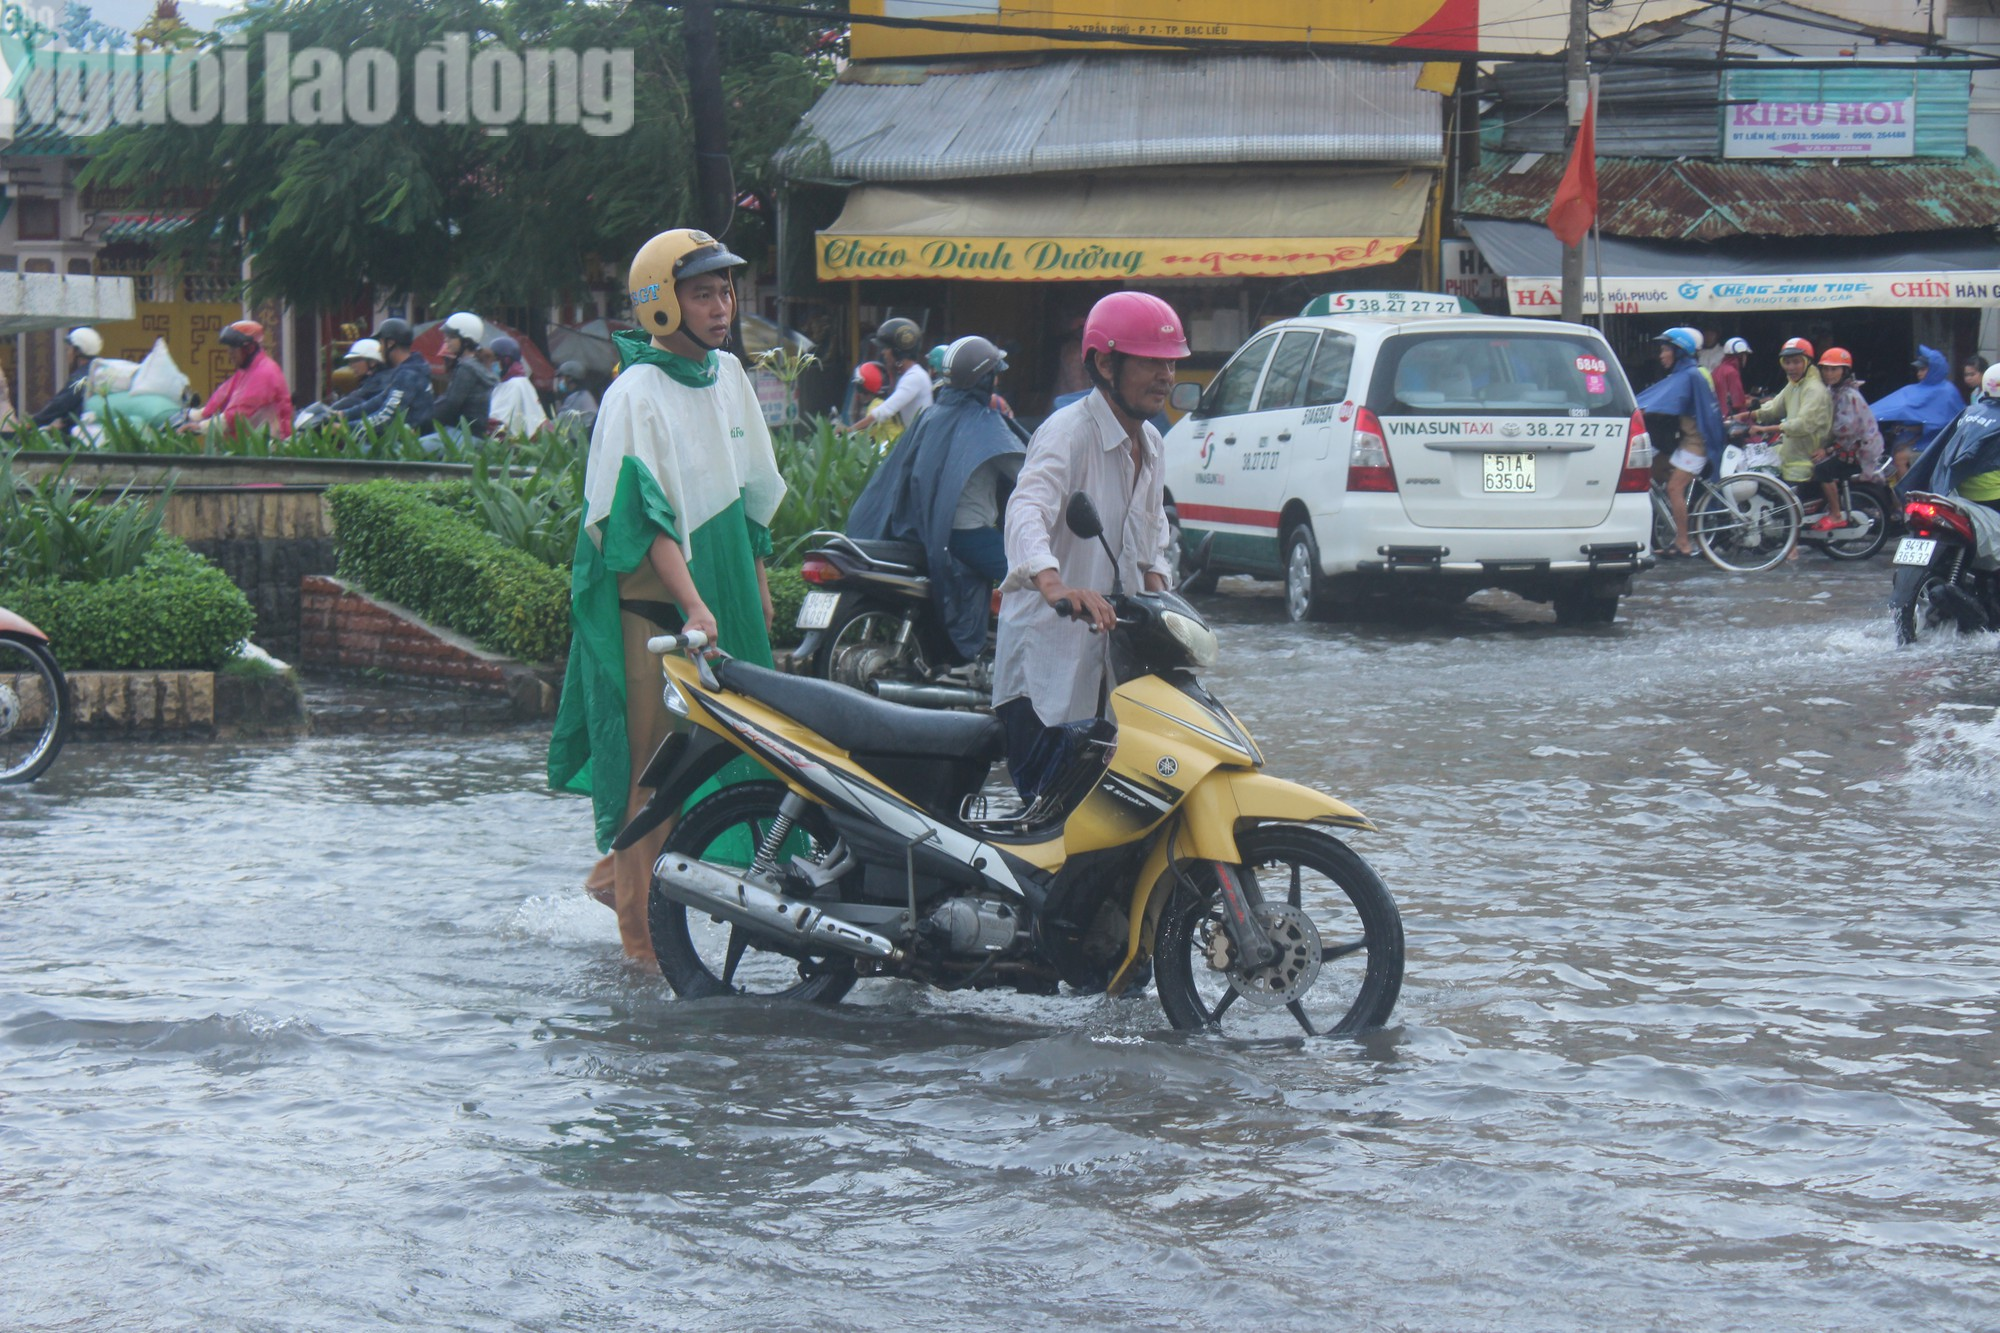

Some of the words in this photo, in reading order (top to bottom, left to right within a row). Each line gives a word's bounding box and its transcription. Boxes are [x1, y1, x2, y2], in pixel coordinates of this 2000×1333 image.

[824, 238, 907, 270] Cháo
[920, 239, 1015, 270] Dinh
[1024, 240, 1146, 274] Dưỡng
[1773, 283, 1818, 294] SHIN
[1890, 278, 1950, 298] CHÍN
[1956, 281, 1988, 298] HÀN
[1412, 300, 1429, 312] 27
[1436, 302, 1455, 313] 27
[1576, 358, 1606, 372] 6849
[1526, 423, 1574, 437] 38.27
[1580, 423, 1599, 437] 27
[1605, 424, 1623, 437] 27
[1496, 456, 1522, 471] 51A
[1486, 473, 1533, 489] 635.04
